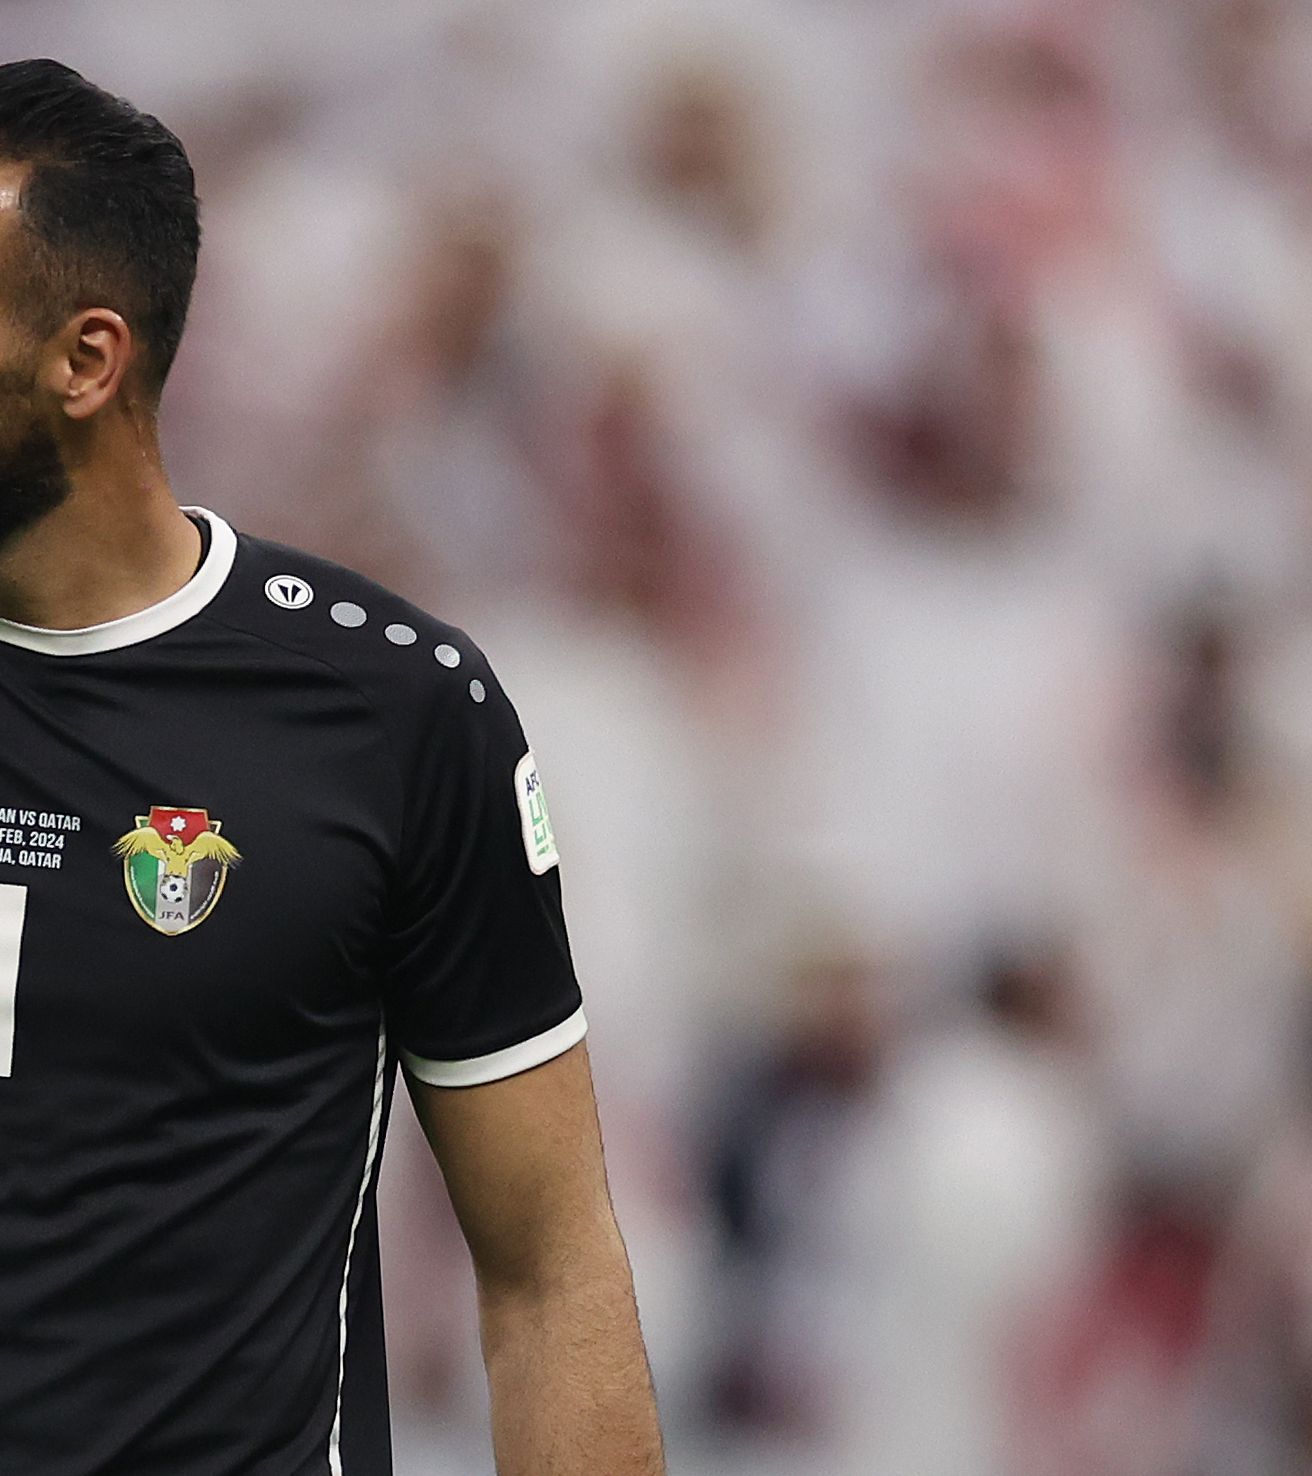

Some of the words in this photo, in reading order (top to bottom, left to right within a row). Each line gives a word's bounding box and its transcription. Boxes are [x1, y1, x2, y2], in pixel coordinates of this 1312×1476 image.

[19, 809, 37, 826] VS
[38, 812, 81, 831] QATAR
[29, 831, 65, 850] 2024
[18, 850, 62, 869] QATAR
[158, 910, 185, 921] JFA
